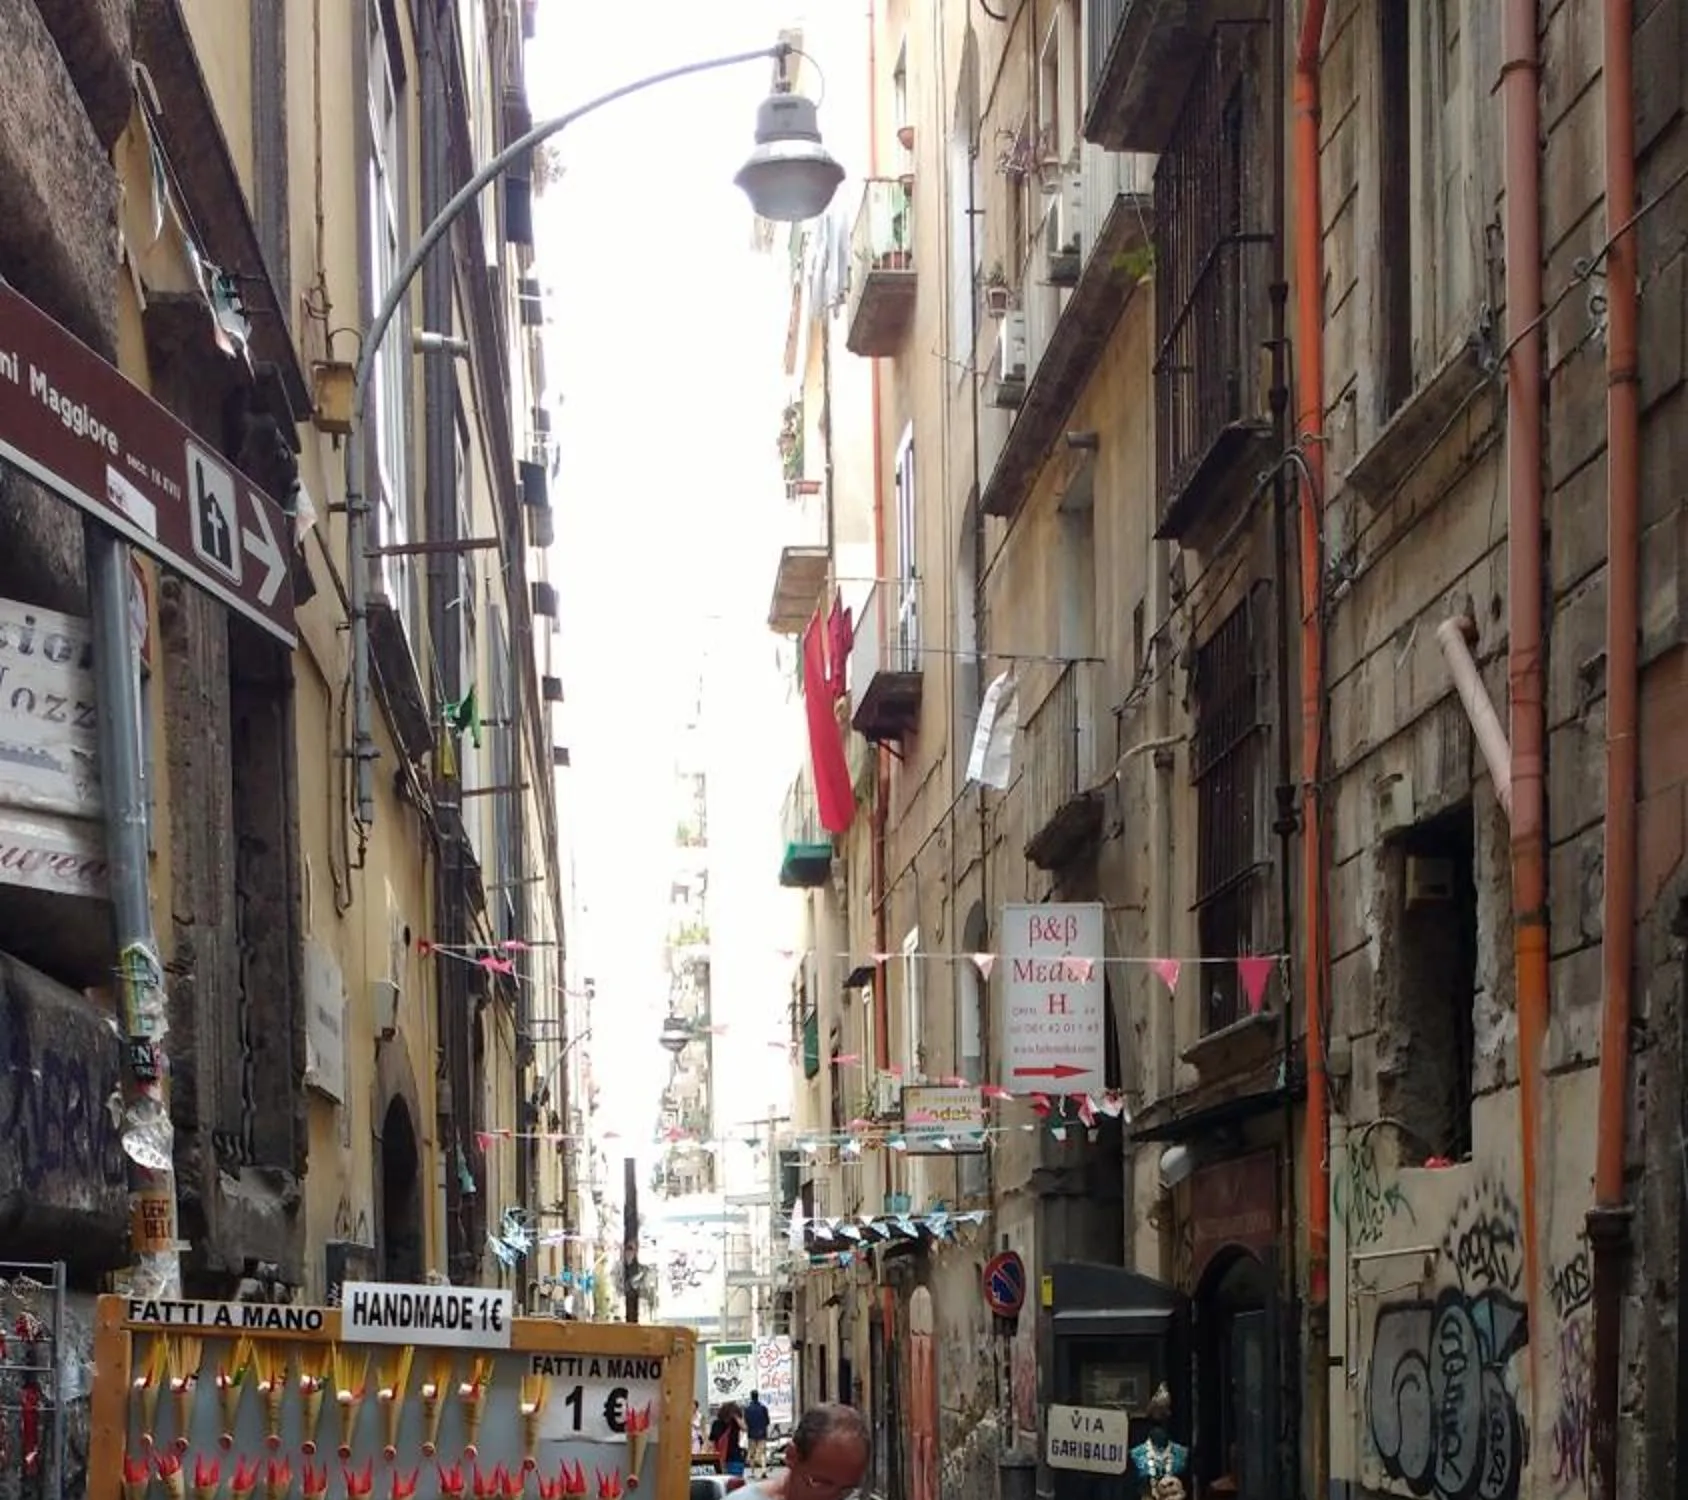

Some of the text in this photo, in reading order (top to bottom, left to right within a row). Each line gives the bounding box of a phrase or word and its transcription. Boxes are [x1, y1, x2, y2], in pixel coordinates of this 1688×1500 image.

[29, 363, 119, 456] Maggiore
[129, 1299, 323, 1331] FATTI A MANO
[353, 1292, 473, 1331] HANDMADE
[532, 1356, 662, 1380] FATTI A MANO
[565, 1385, 583, 1432] 1
[1070, 1413, 1105, 1434] VIA
[1051, 1439, 1124, 1463] GARIBALDI
